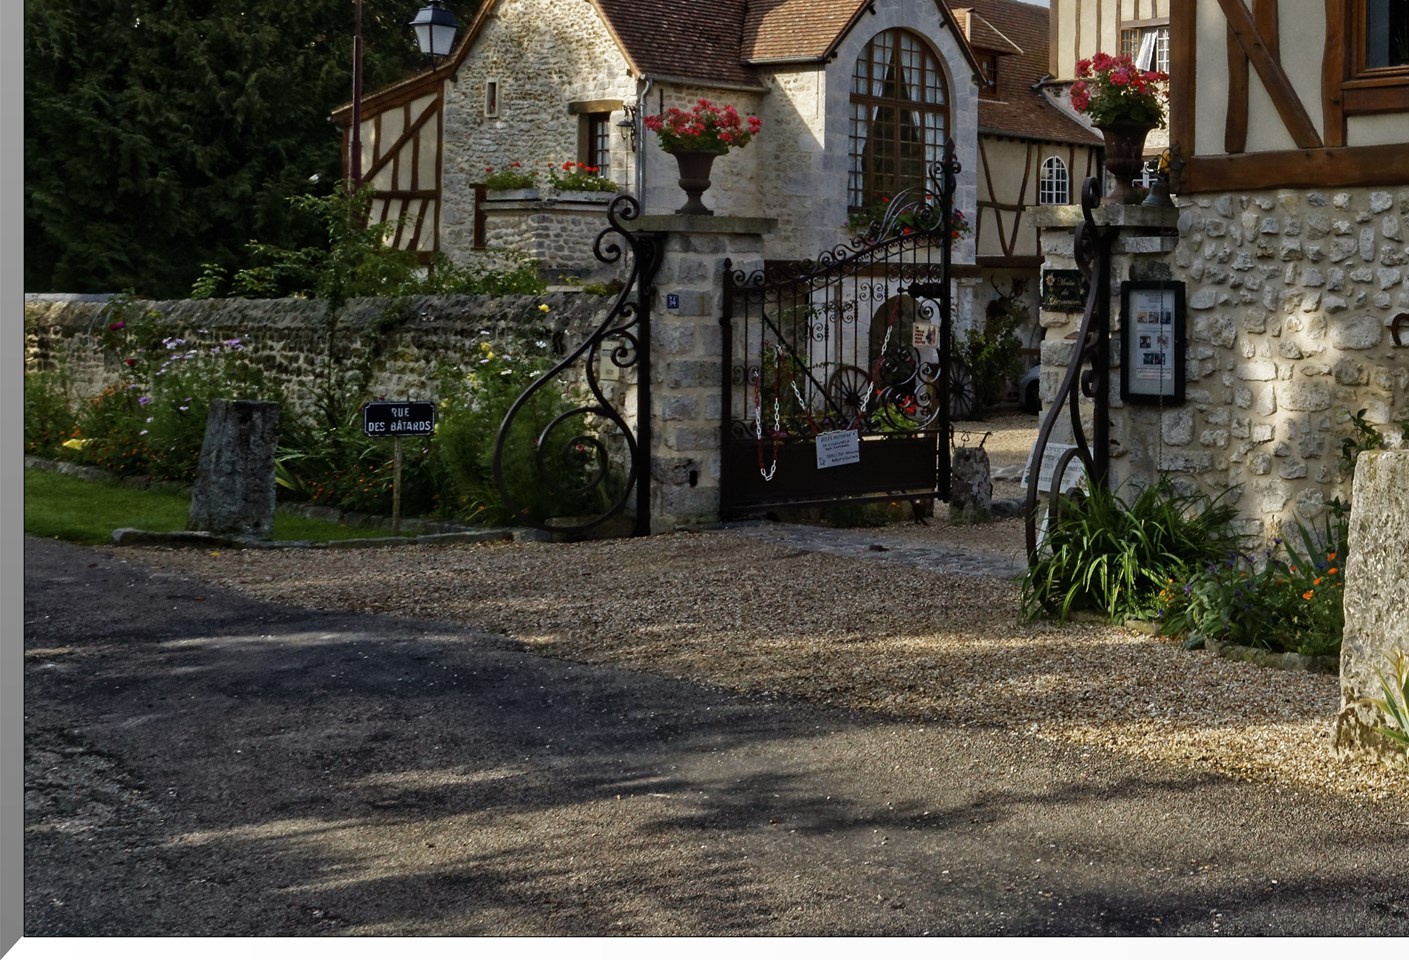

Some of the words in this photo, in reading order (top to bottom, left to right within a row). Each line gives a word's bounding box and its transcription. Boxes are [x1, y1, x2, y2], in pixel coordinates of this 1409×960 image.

[391, 407, 410, 417] RUE
[368, 422, 386, 432] DES
[390, 419, 431, 431] BÂTARDS
